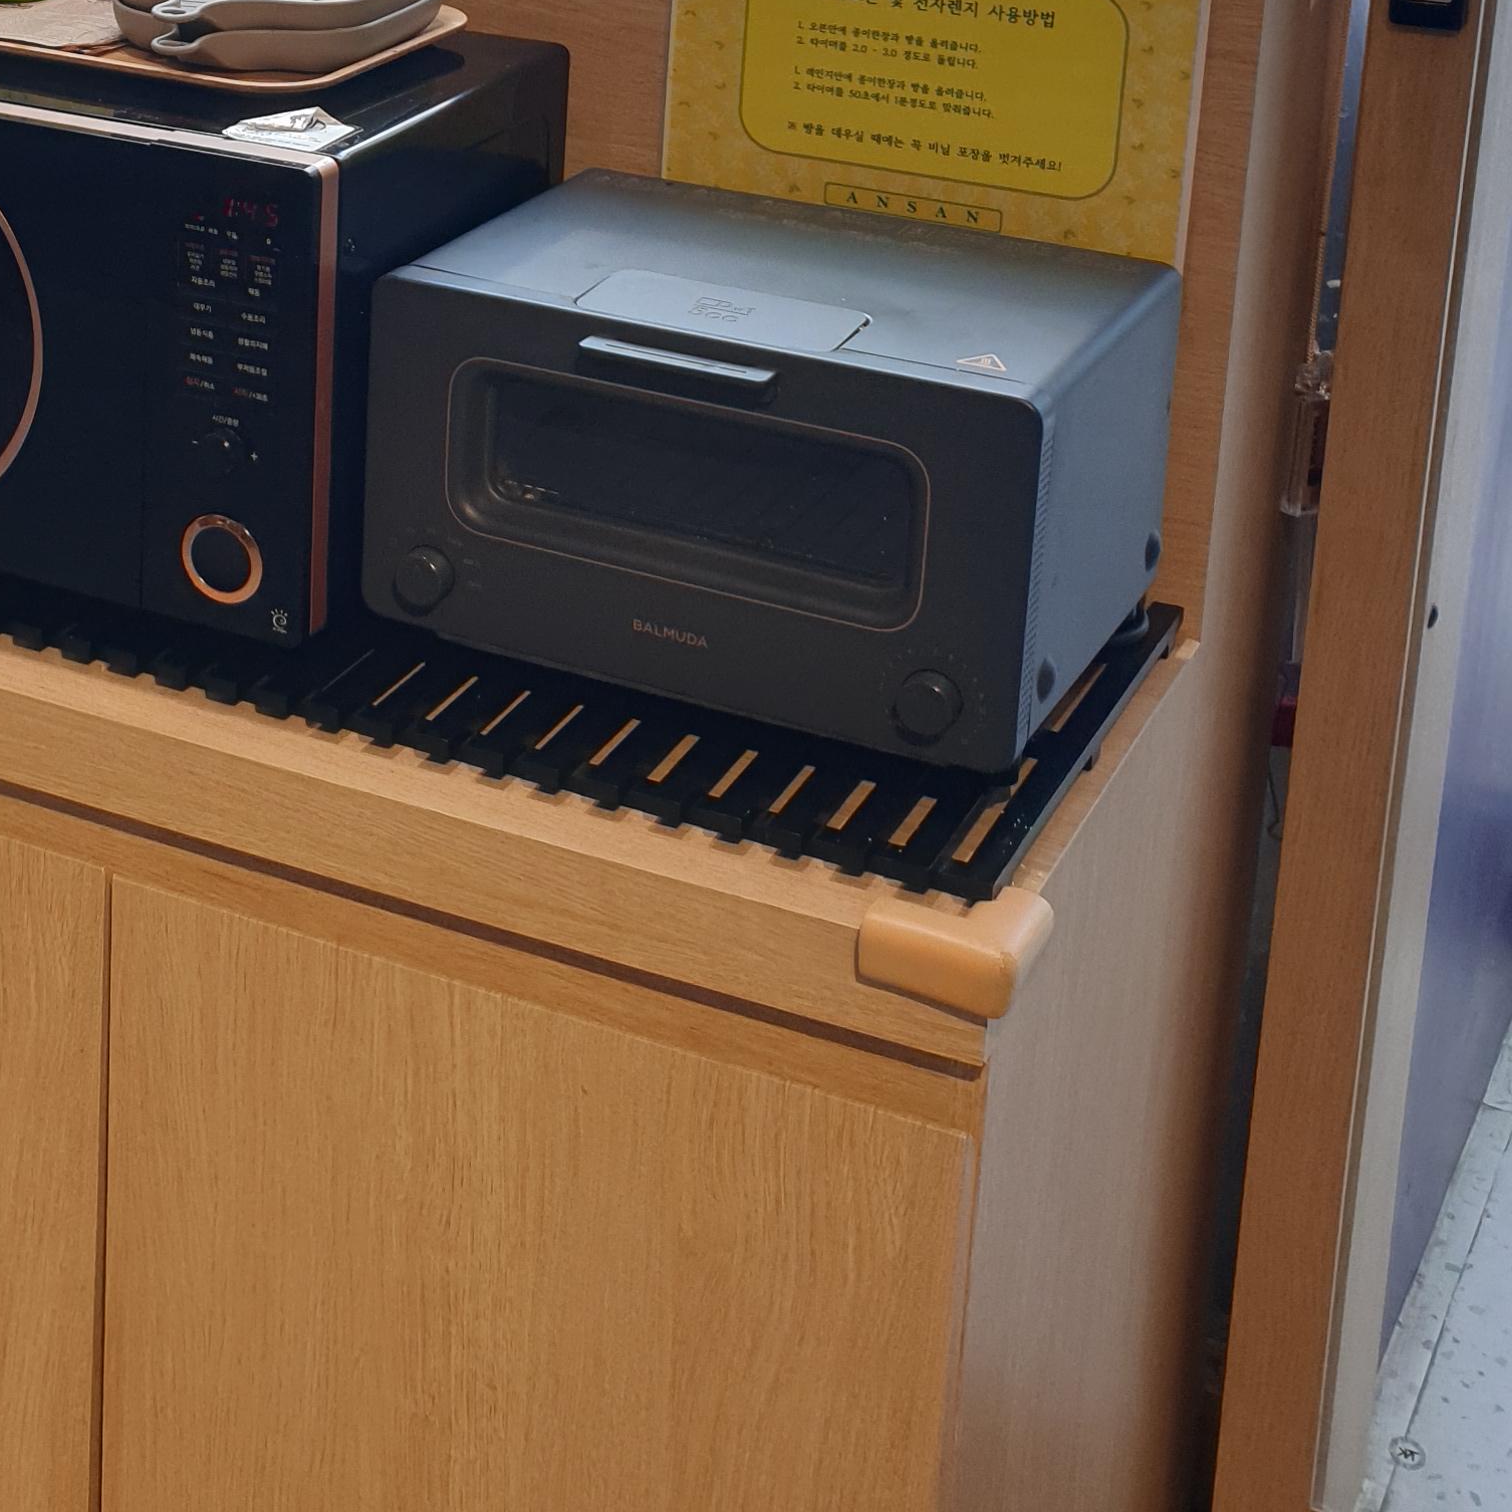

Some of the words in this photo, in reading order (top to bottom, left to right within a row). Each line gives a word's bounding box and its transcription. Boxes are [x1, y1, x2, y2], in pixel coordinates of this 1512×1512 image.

[988, 4, 1056, 29] 사용방법
[903, 49, 931, 63] 정도로
[802, 121, 825, 138] 빵을
[831, 126, 864, 144] 데우실
[928, 142, 951, 157] 비닐
[956, 145, 992, 164] 포장을
[846, 190, 980, 226] ANSAN
[632, 618, 709, 649] BALMUDA
